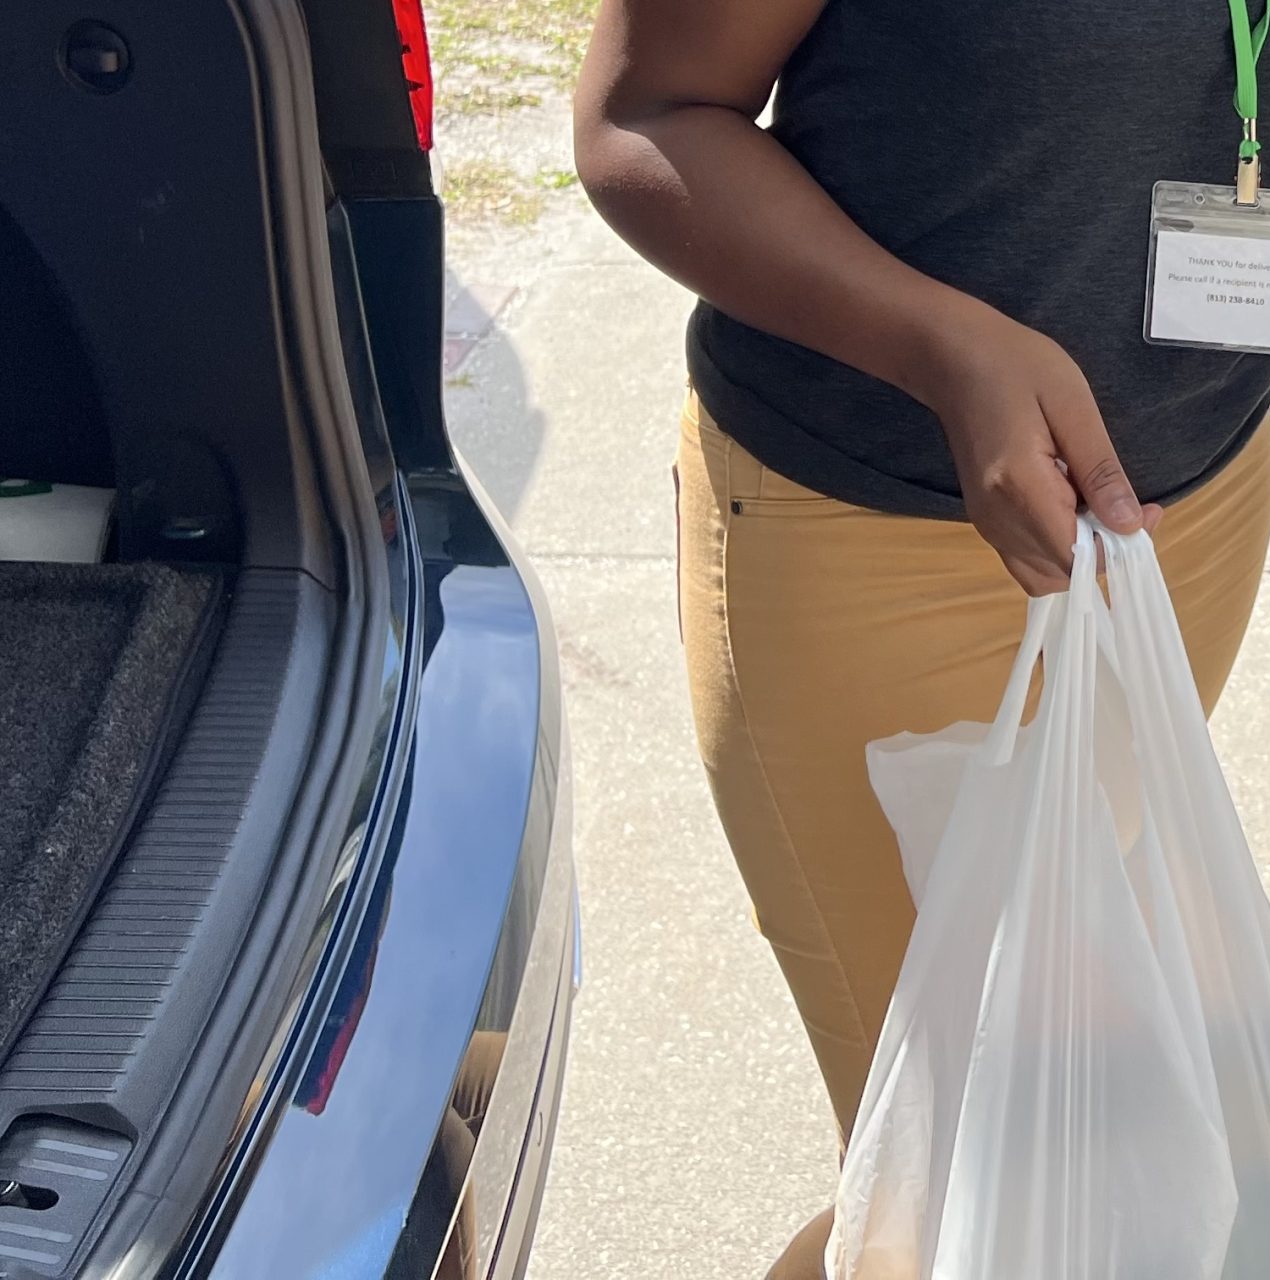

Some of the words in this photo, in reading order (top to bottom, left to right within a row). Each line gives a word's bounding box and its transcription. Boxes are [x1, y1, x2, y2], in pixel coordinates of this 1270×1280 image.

[1188, 256, 1215, 266] THANK
[1216, 259, 1233, 269] YOU
[1235, 260, 1246, 269] for
[1168, 272, 1192, 282] Please
[1194, 275, 1208, 283] call
[1222, 279, 1257, 289] recipient
